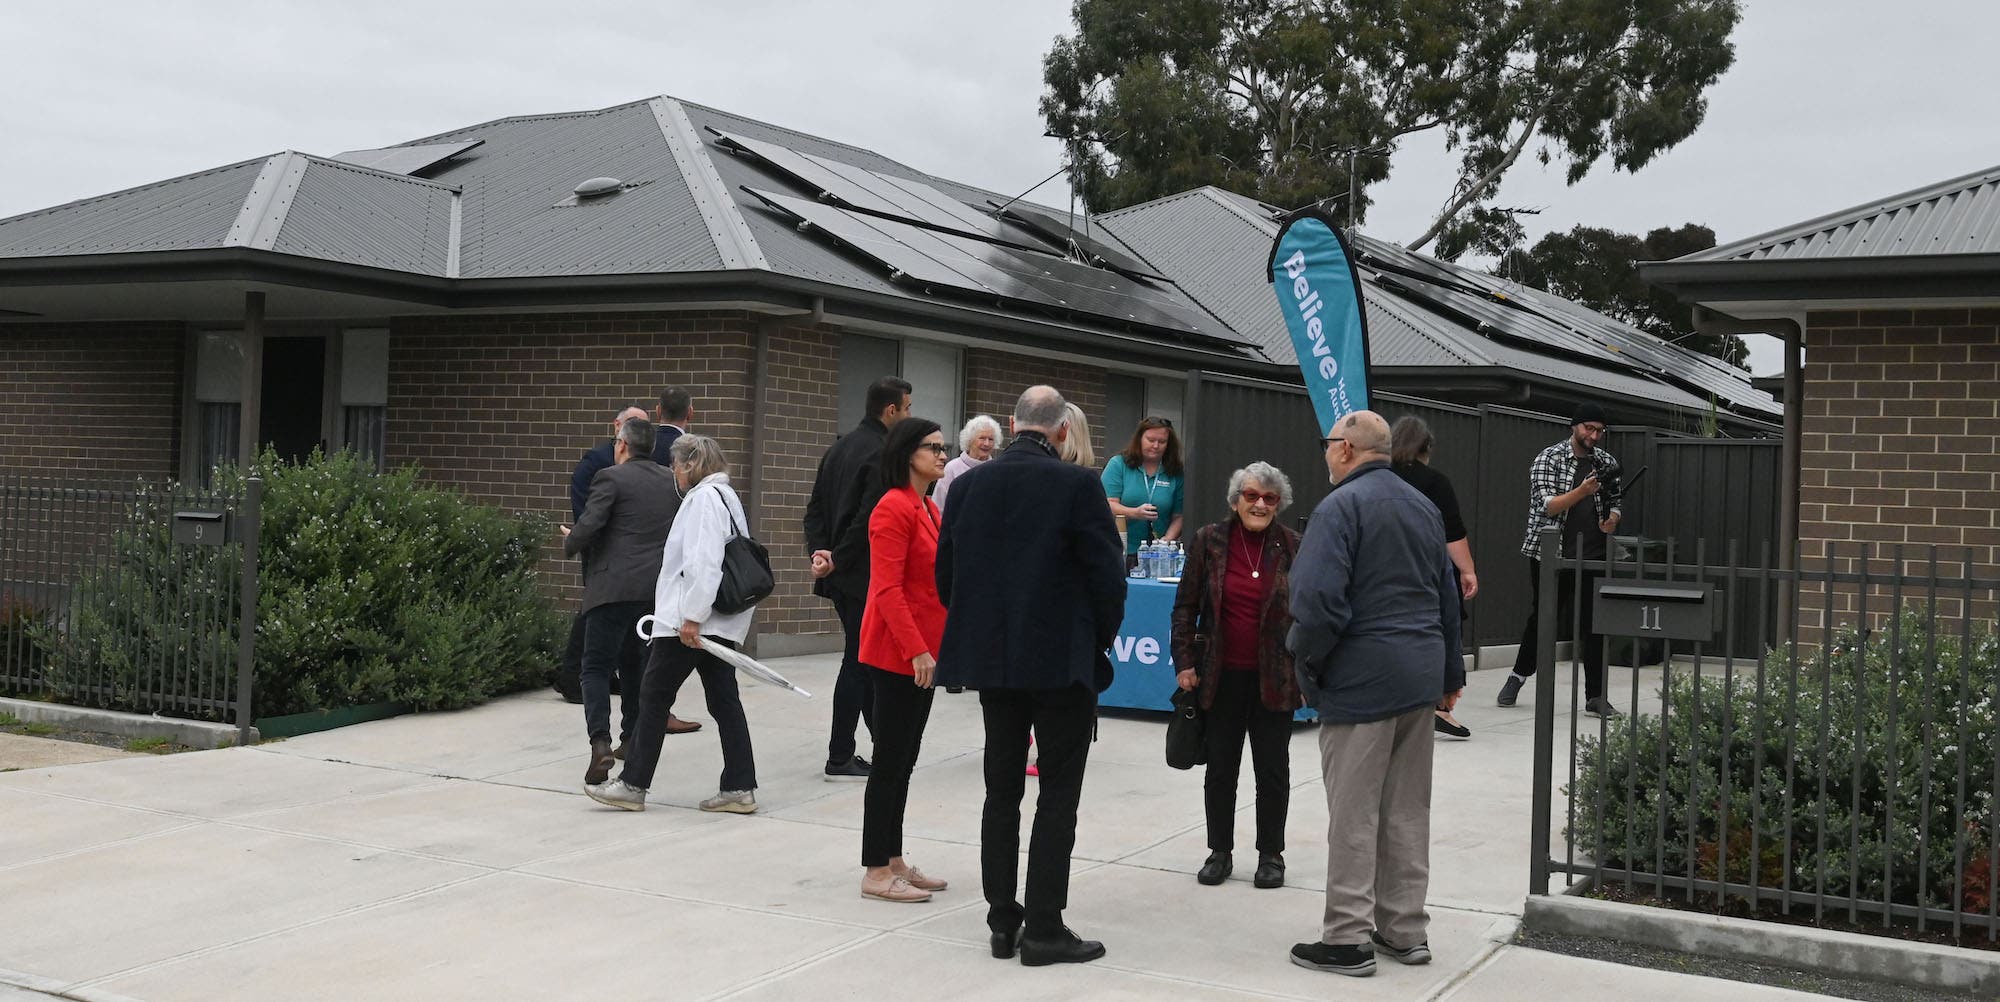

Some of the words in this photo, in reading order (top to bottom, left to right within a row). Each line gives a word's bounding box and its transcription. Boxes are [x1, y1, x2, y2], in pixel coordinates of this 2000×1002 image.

[1283, 249, 1338, 380] Believe
[195, 524, 203, 540] 9
[1640, 605, 1662, 631] 11
[1104, 635, 1160, 665] ve
